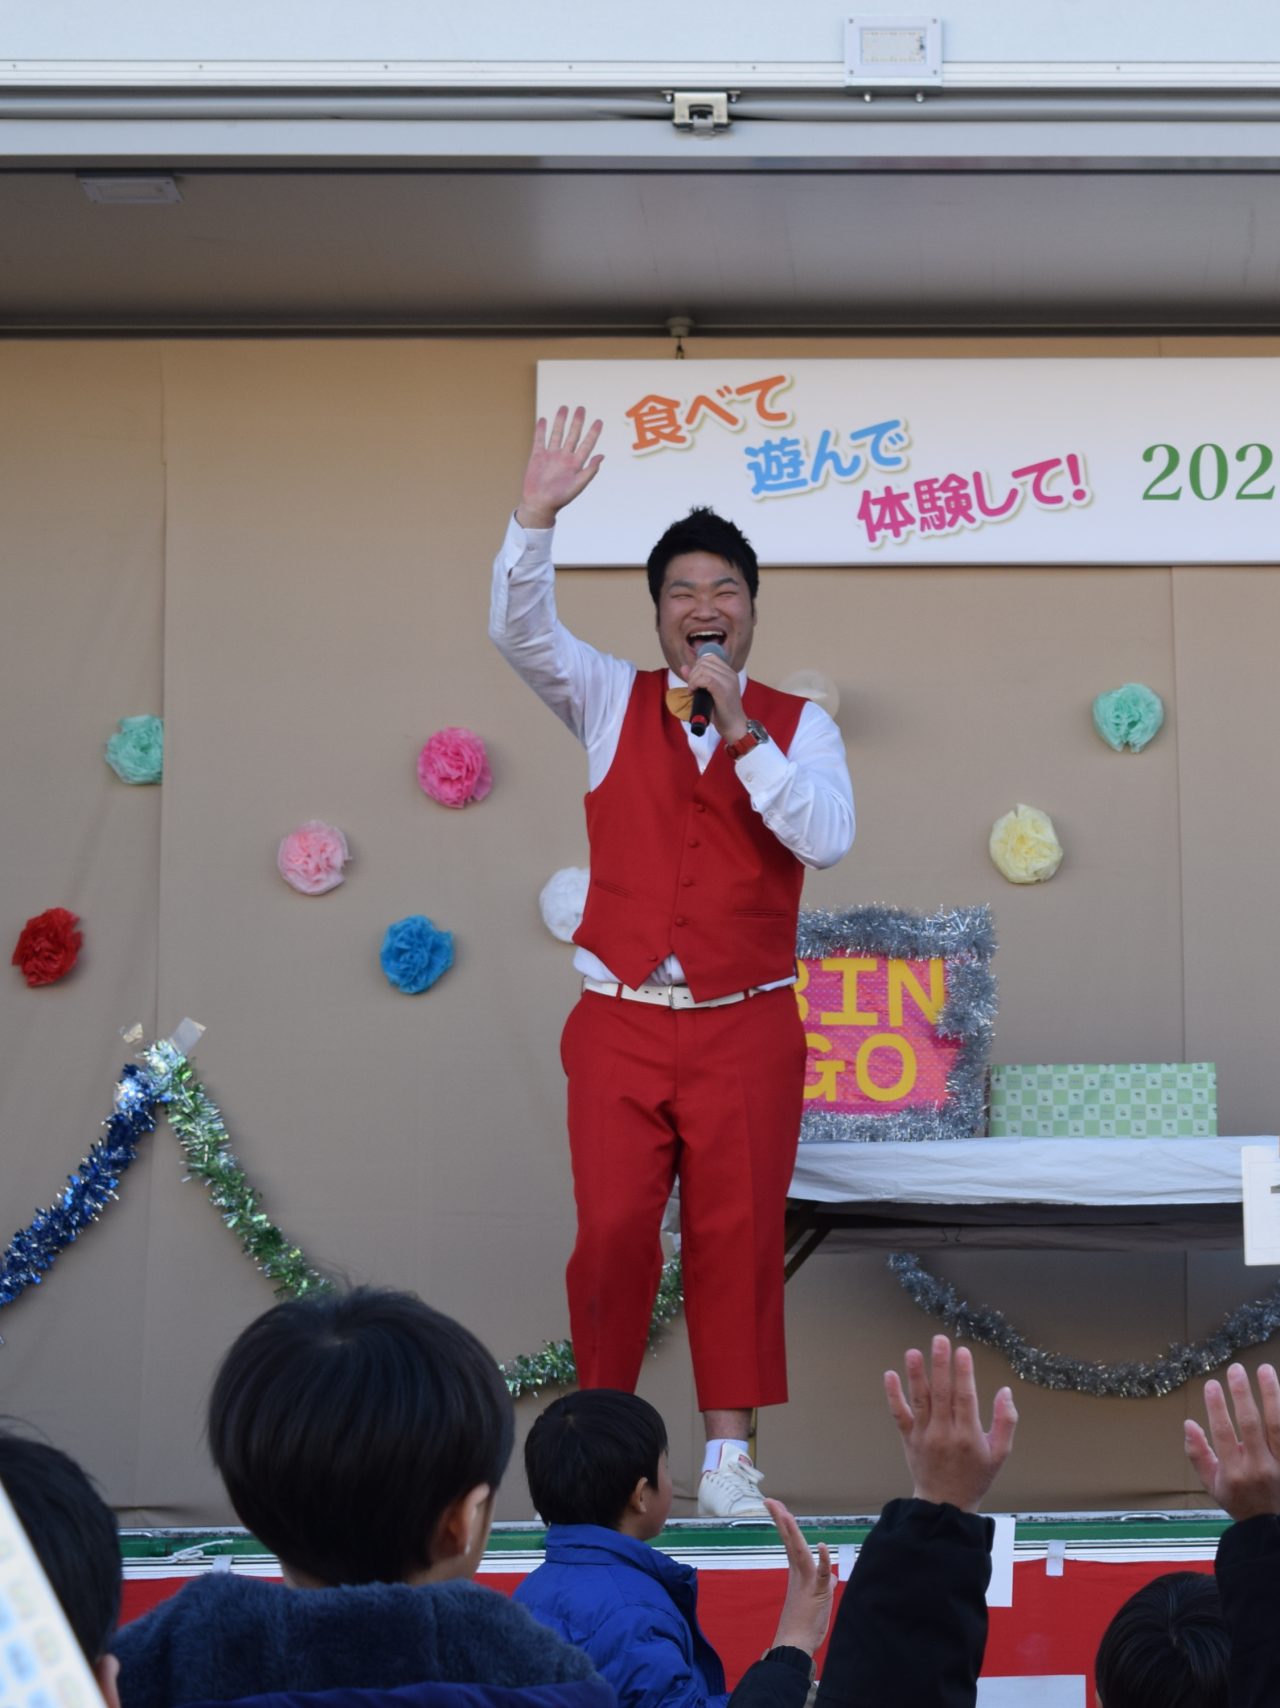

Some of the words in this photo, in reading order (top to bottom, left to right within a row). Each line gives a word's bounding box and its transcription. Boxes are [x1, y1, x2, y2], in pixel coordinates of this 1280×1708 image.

[625, 374, 788, 451] 食べて
[743, 418, 905, 495] 遊んで
[856, 453, 1088, 543] 体験して!
[803, 1032, 918, 1102] GO
